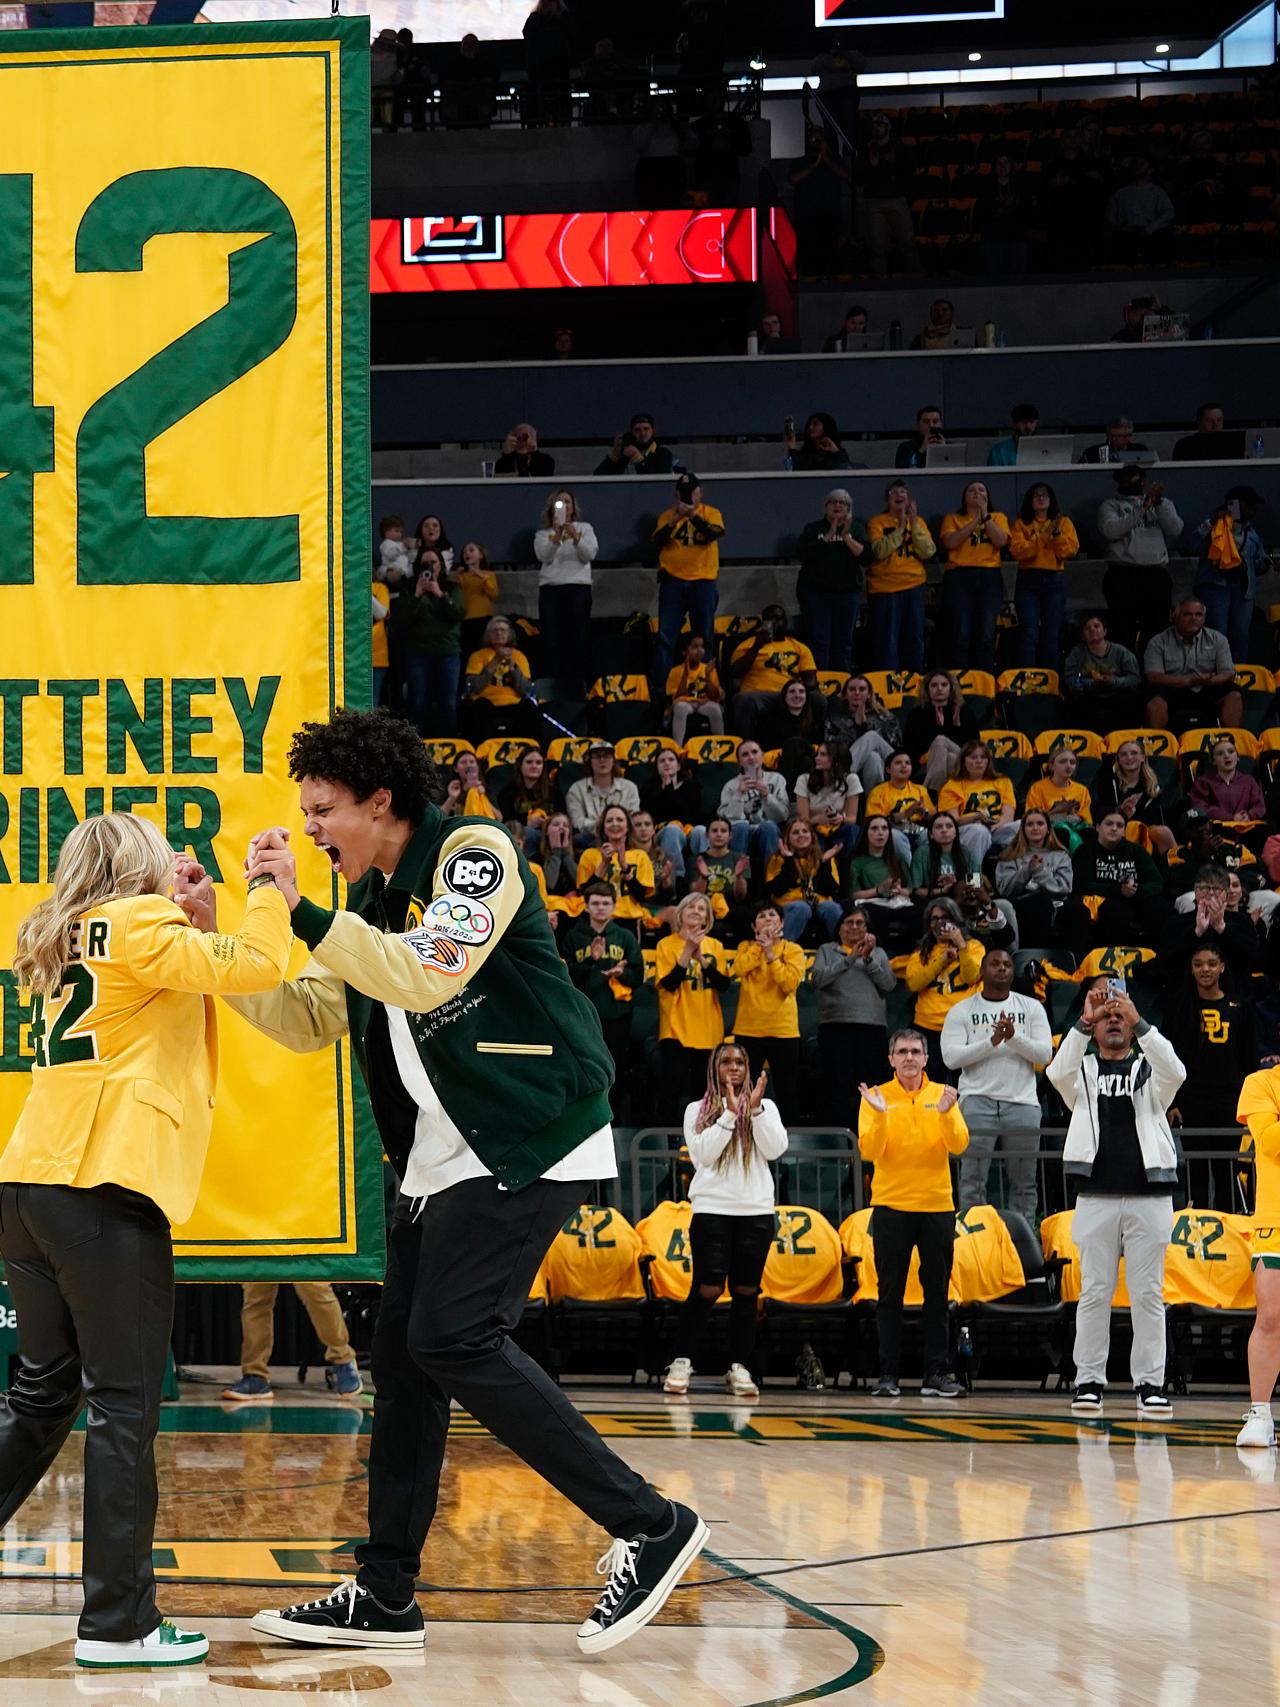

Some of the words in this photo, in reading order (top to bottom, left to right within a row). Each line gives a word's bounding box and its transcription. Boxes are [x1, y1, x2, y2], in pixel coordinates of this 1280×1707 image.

[765, 651, 801, 675] 42
[699, 739, 735, 762] 42
[966, 790, 1002, 821] 42
[452, 859, 495, 887] BG
[433, 923, 473, 940] 2016/2020
[563, 1205, 616, 1248] 42
[1170, 1215, 1227, 1261] 42
